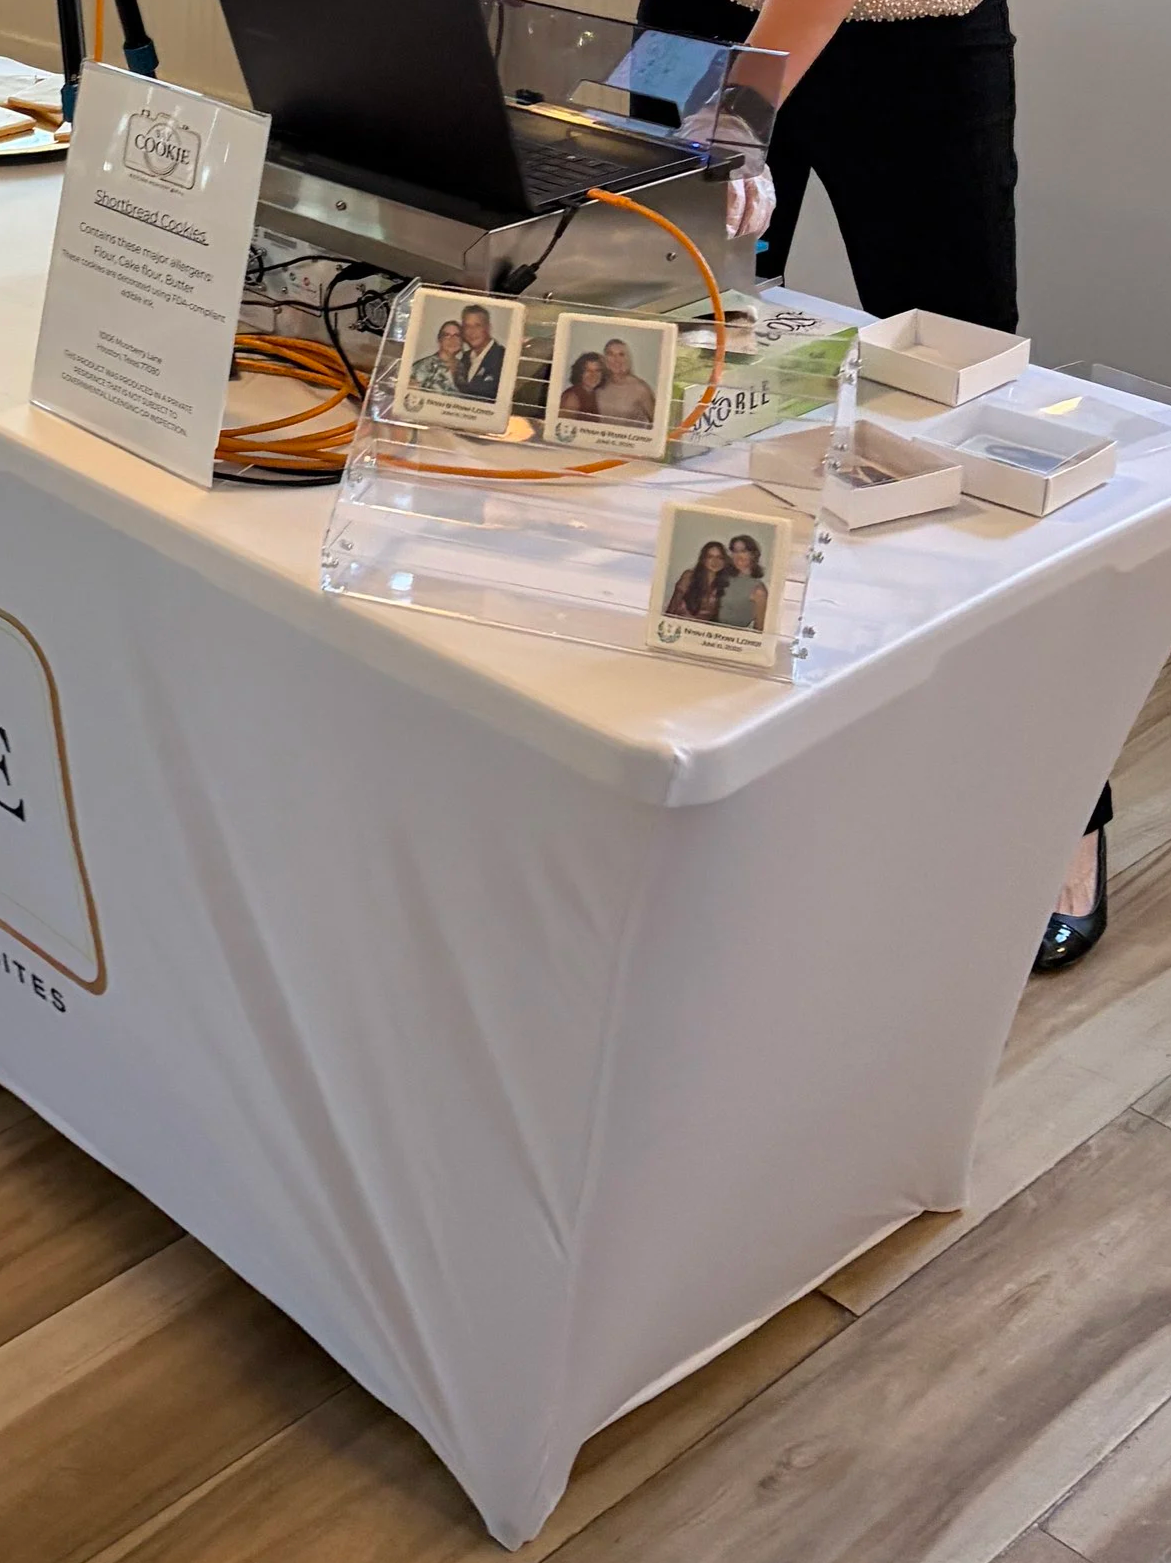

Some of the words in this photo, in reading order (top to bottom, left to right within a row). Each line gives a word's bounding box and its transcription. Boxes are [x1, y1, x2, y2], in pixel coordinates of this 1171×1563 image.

[134, 133, 191, 165] COOKIE
[95, 189, 160, 224] Shortbread
[160, 213, 209, 244] Cookies
[79, 221, 116, 245] Contains
[117, 237, 142, 255] these
[142, 248, 170, 264] major
[81, 258, 105, 274] cookies
[105, 269, 117, 279] are
[117, 273, 151, 293] decorated
[151, 287, 171, 301] using
[93, 245, 117, 265] Flour,
[118, 255, 140, 273] Cake
[164, 273, 195, 293] Butter
[120, 289, 142, 303] edible
